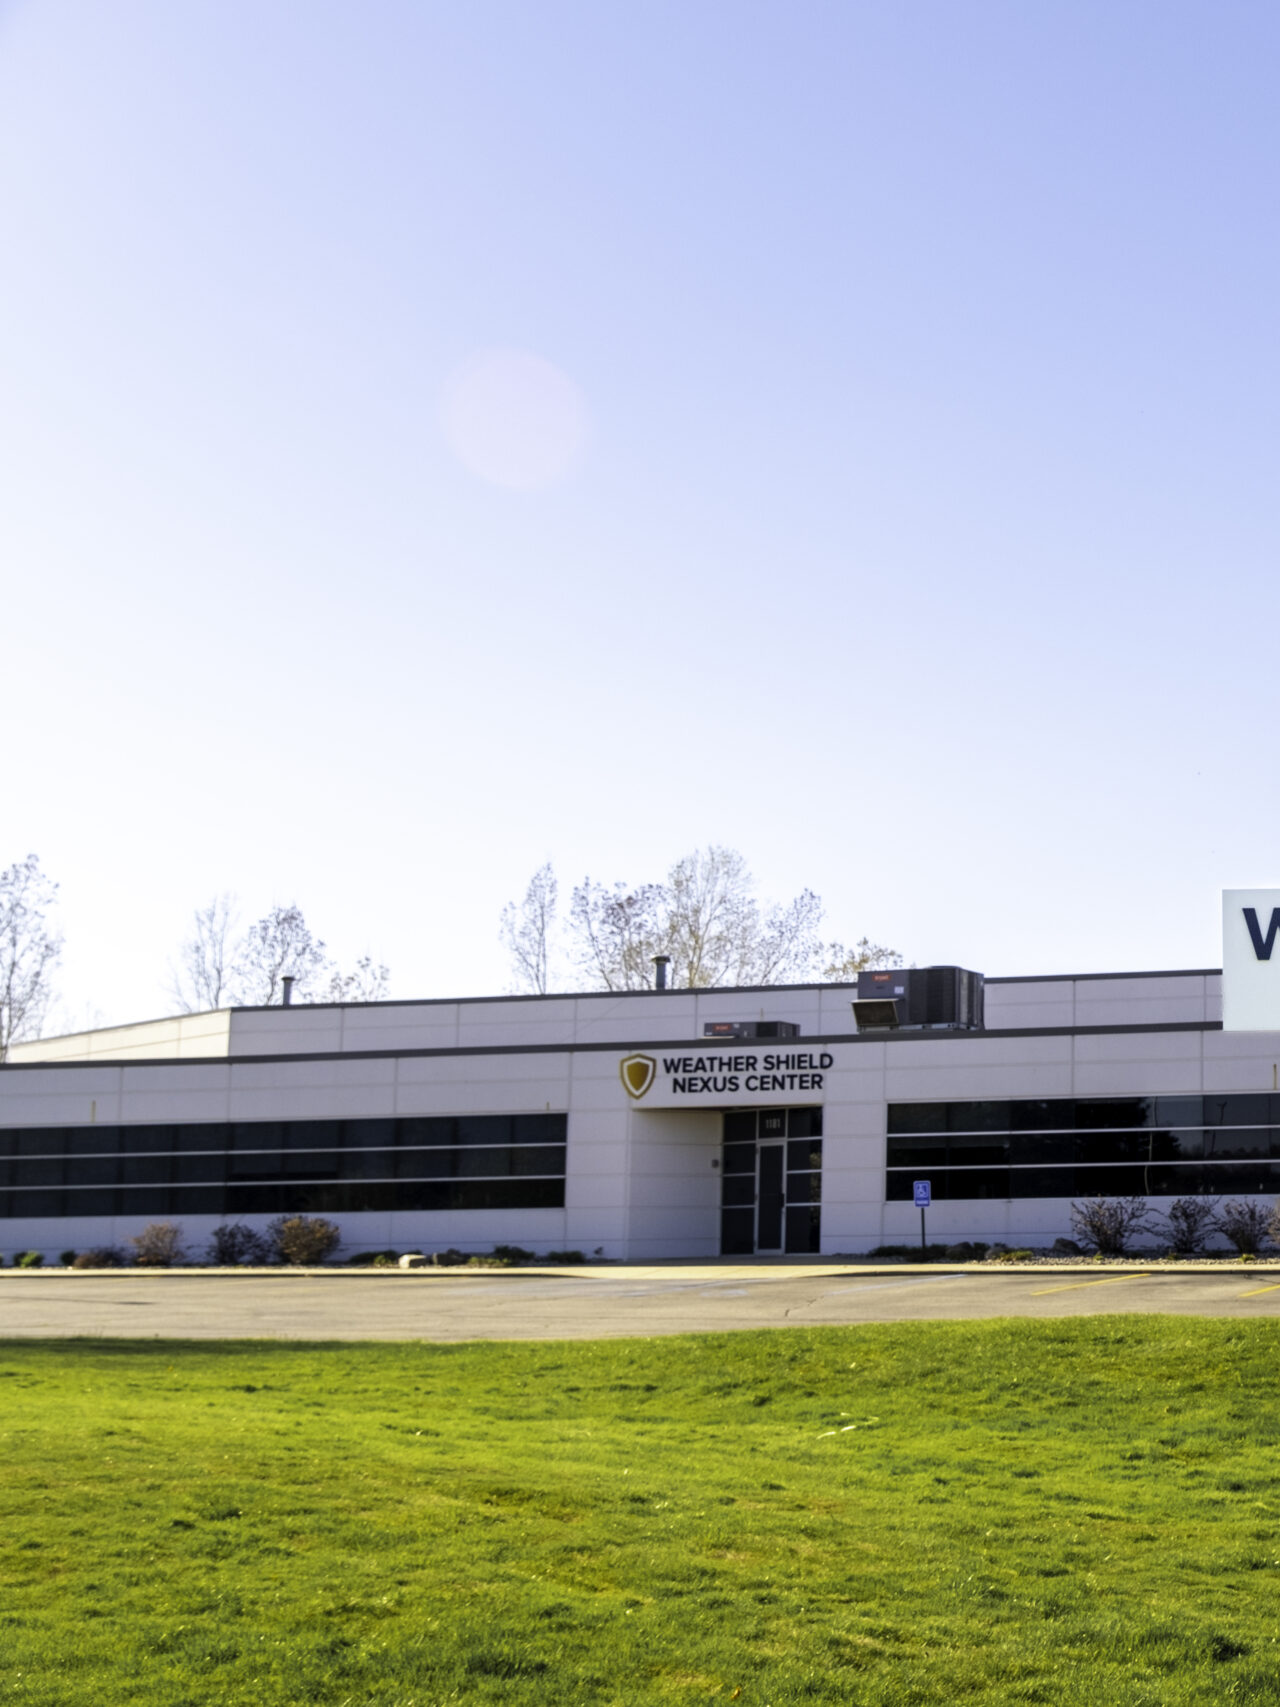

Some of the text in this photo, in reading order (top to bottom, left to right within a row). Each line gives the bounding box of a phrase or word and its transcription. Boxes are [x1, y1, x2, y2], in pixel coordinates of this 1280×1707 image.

[662, 1052, 834, 1074] WEATHER SHIELD
[672, 1073, 824, 1094] NEXUS CENTER
